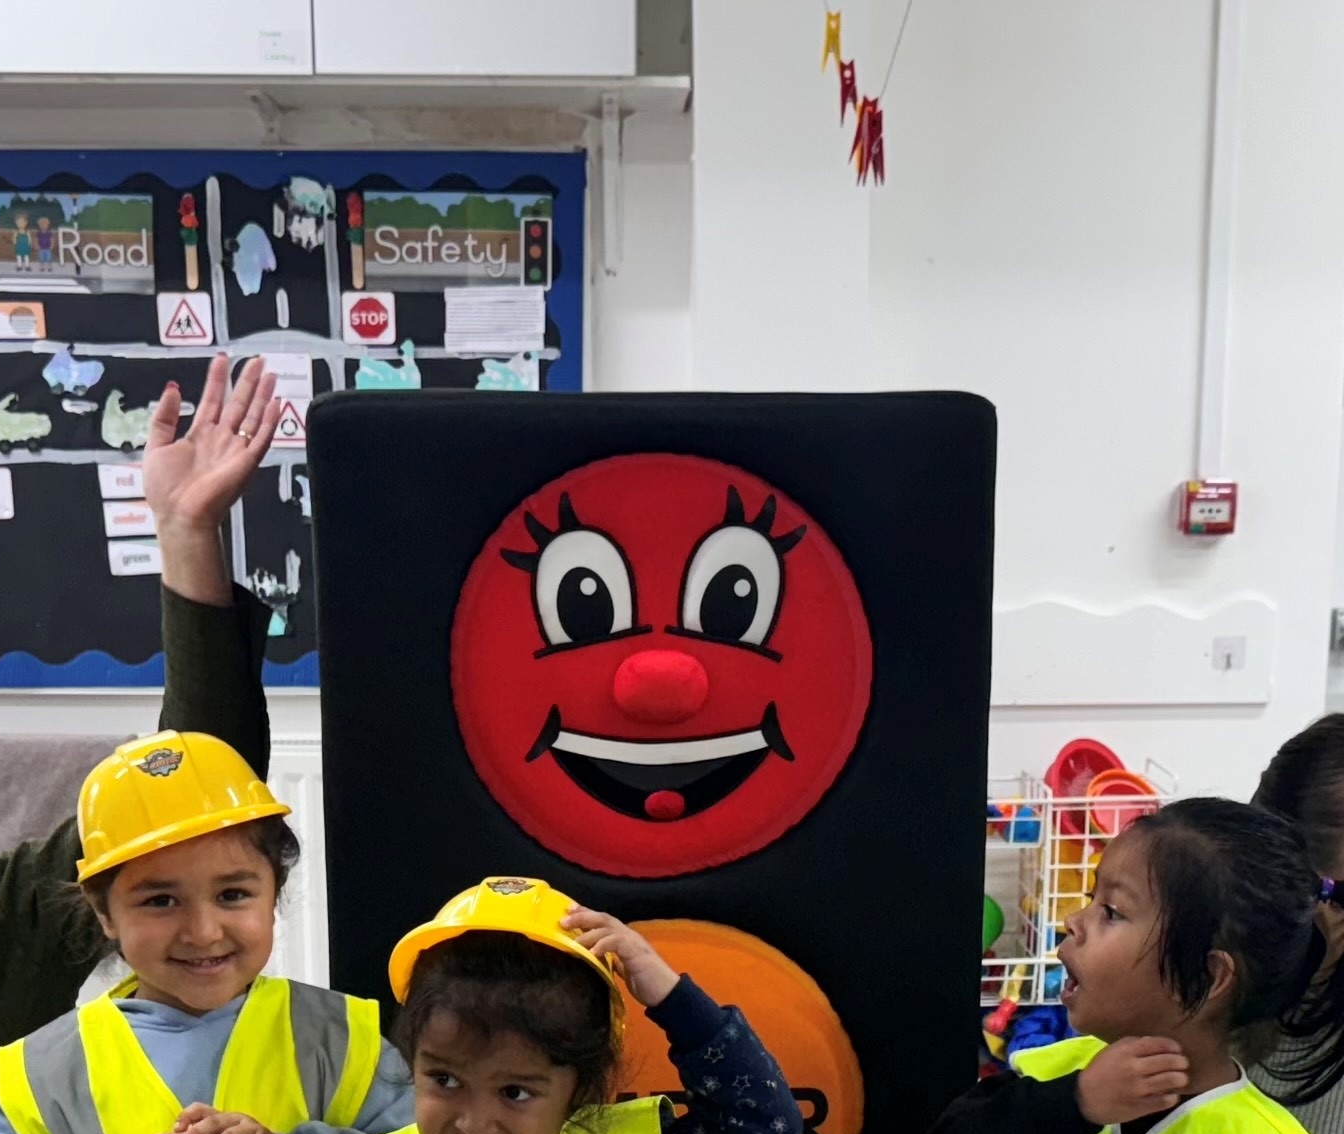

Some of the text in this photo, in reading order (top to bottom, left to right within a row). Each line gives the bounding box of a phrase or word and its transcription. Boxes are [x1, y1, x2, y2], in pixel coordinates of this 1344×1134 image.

[57, 225, 149, 268] Road
[373, 224, 507, 278] Safety
[350, 311, 389, 327] STOP
[115, 473, 136, 487] red
[121, 554, 152, 567] green
